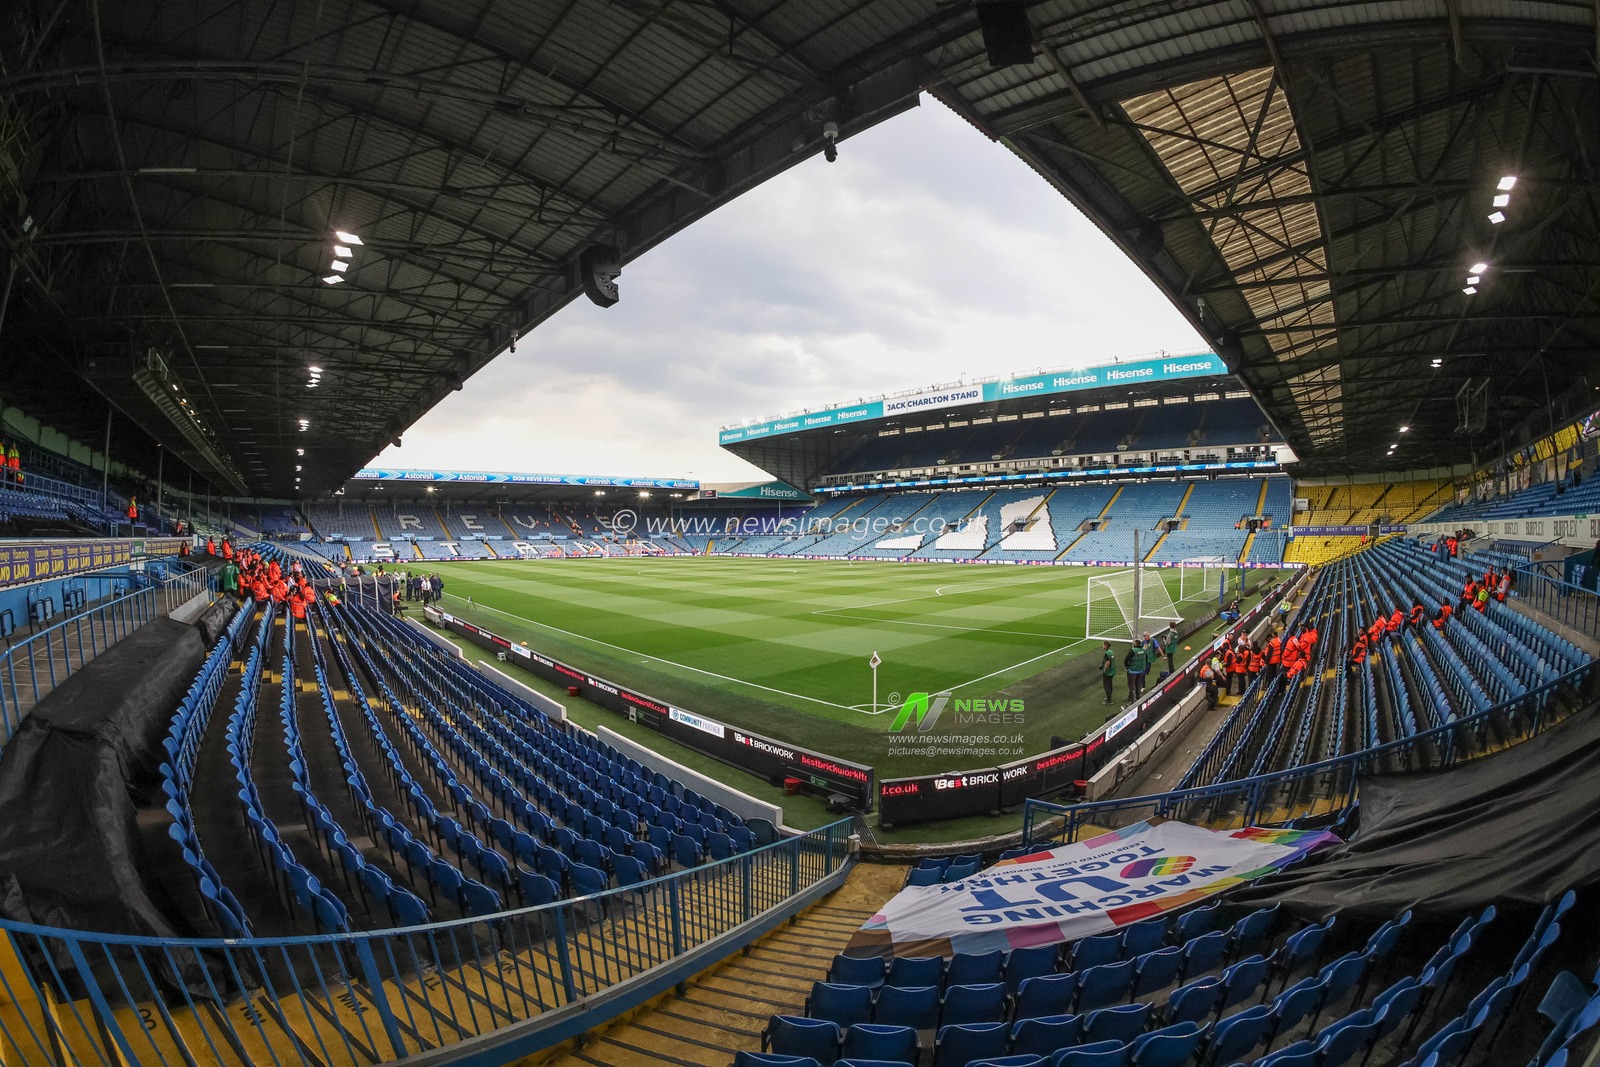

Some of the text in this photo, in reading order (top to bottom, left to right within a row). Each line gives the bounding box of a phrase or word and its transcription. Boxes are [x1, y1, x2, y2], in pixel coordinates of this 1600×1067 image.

[1003, 382, 1044, 394] Hisense
[1054, 374, 1097, 388] Hisense
[1107, 367, 1153, 380] Hisense
[1164, 361, 1212, 374] Hisense
[886, 390, 978, 410] JACK CHARLTON STAND
[722, 409, 867, 441] Hisense Hisense Hisense Hisense Hisense
[760, 487, 798, 497] Hisense
[0, 566, 10, 581] ND
[14, 564, 30, 579] LAND
[36, 562, 49, 576] LAND
[52, 560, 64, 573] LAND
[680, 713, 702, 728] COMMUNITY
[754, 740, 794, 760] BRICKWORK
[970, 773, 999, 785] BRICK
[1003, 766, 1028, 780] WORK
[962, 864, 1231, 925] MARCHING
